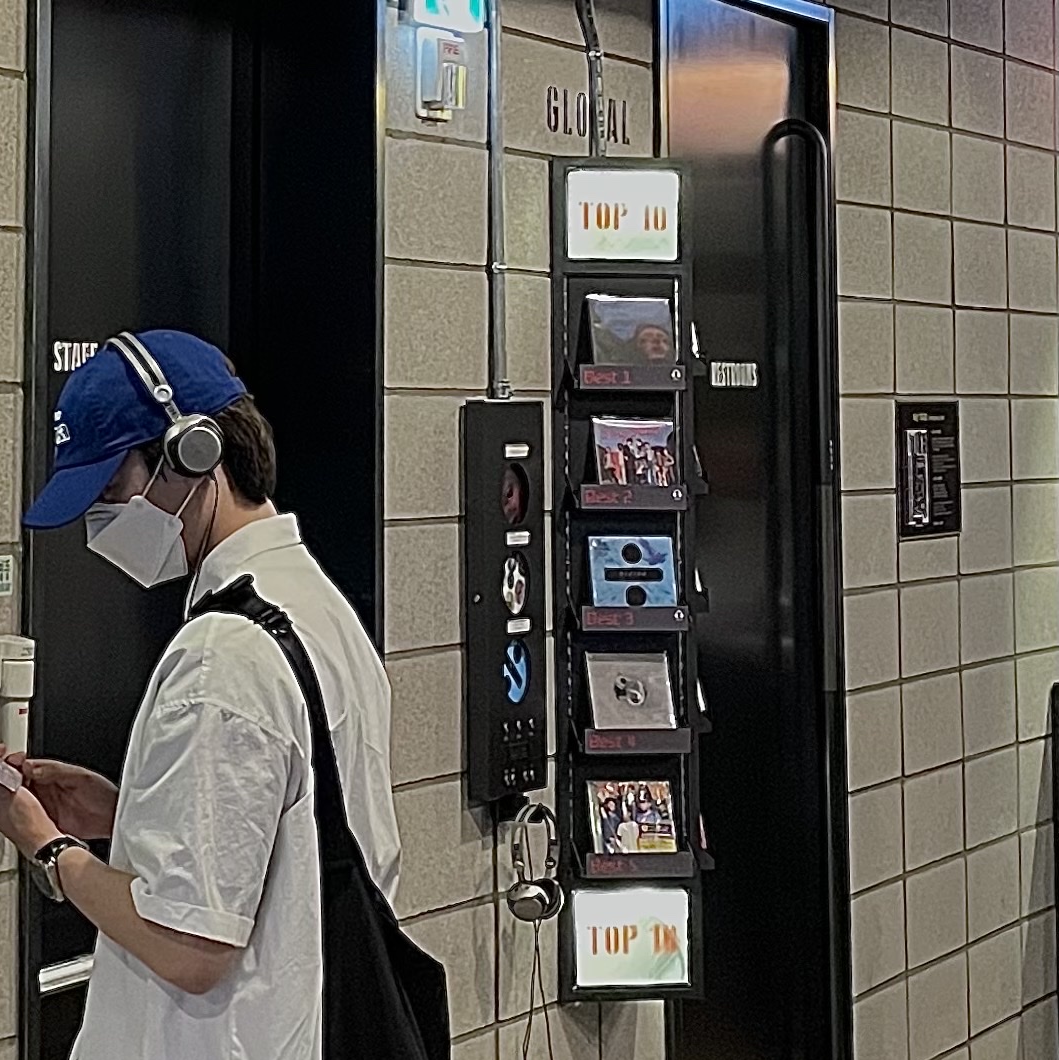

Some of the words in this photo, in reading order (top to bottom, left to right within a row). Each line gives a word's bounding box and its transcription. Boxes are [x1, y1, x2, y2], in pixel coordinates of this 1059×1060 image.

[546, 86, 630, 145] GLOAL
[578, 201, 628, 231] TOP
[643, 204, 667, 231] 10
[583, 370, 617, 385] Best
[622, 370, 631, 385] 1
[624, 611, 634, 626] 3
[586, 924, 638, 955] TOP
